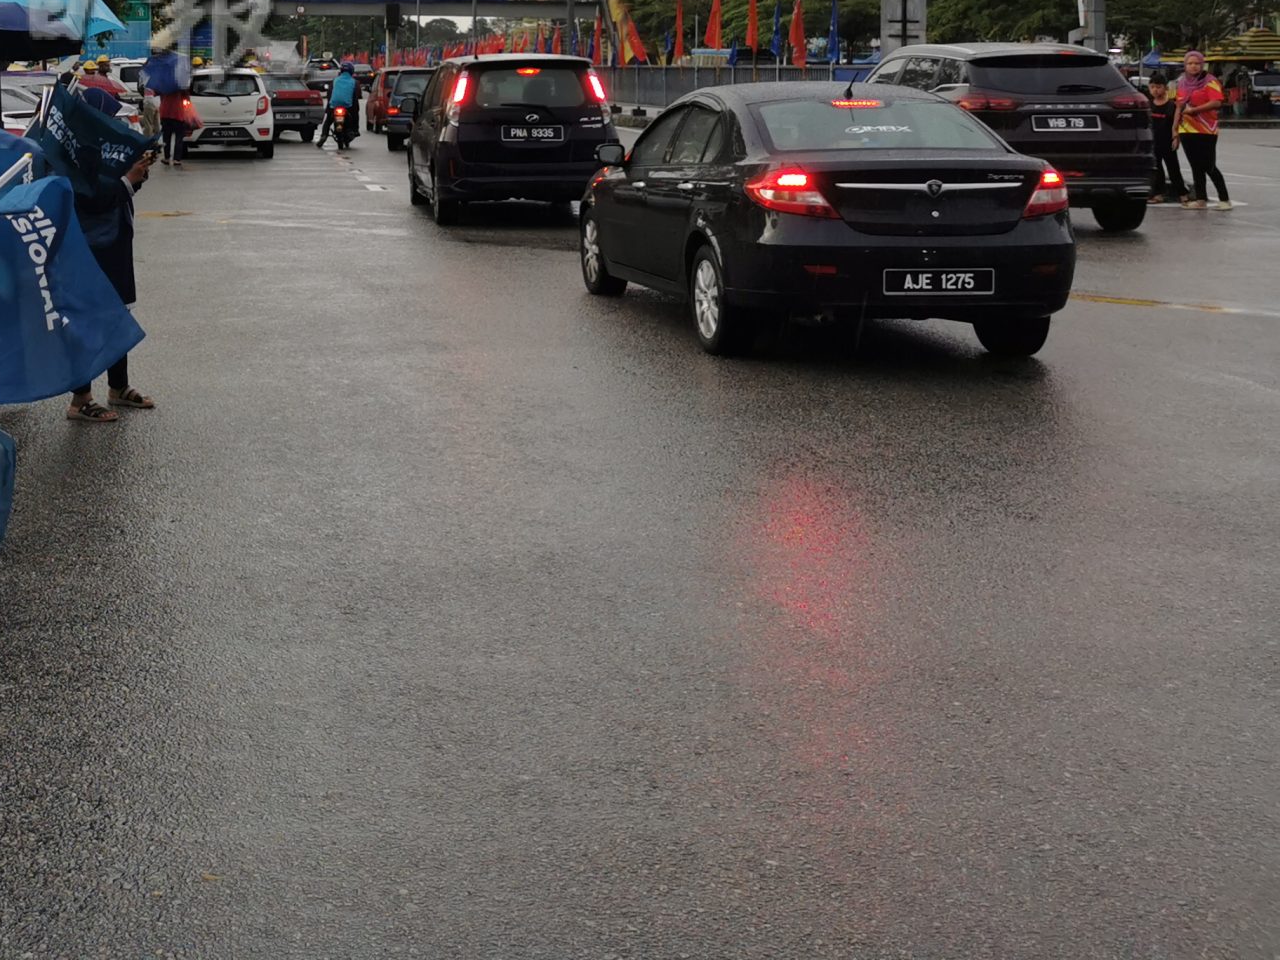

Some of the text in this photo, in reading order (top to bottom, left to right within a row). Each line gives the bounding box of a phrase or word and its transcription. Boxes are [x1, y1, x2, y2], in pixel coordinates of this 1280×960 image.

[1047, 118, 1084, 128] VHB 719
[510, 128, 554, 138] PNA 9335
[903, 273, 975, 289] AJE 1275
